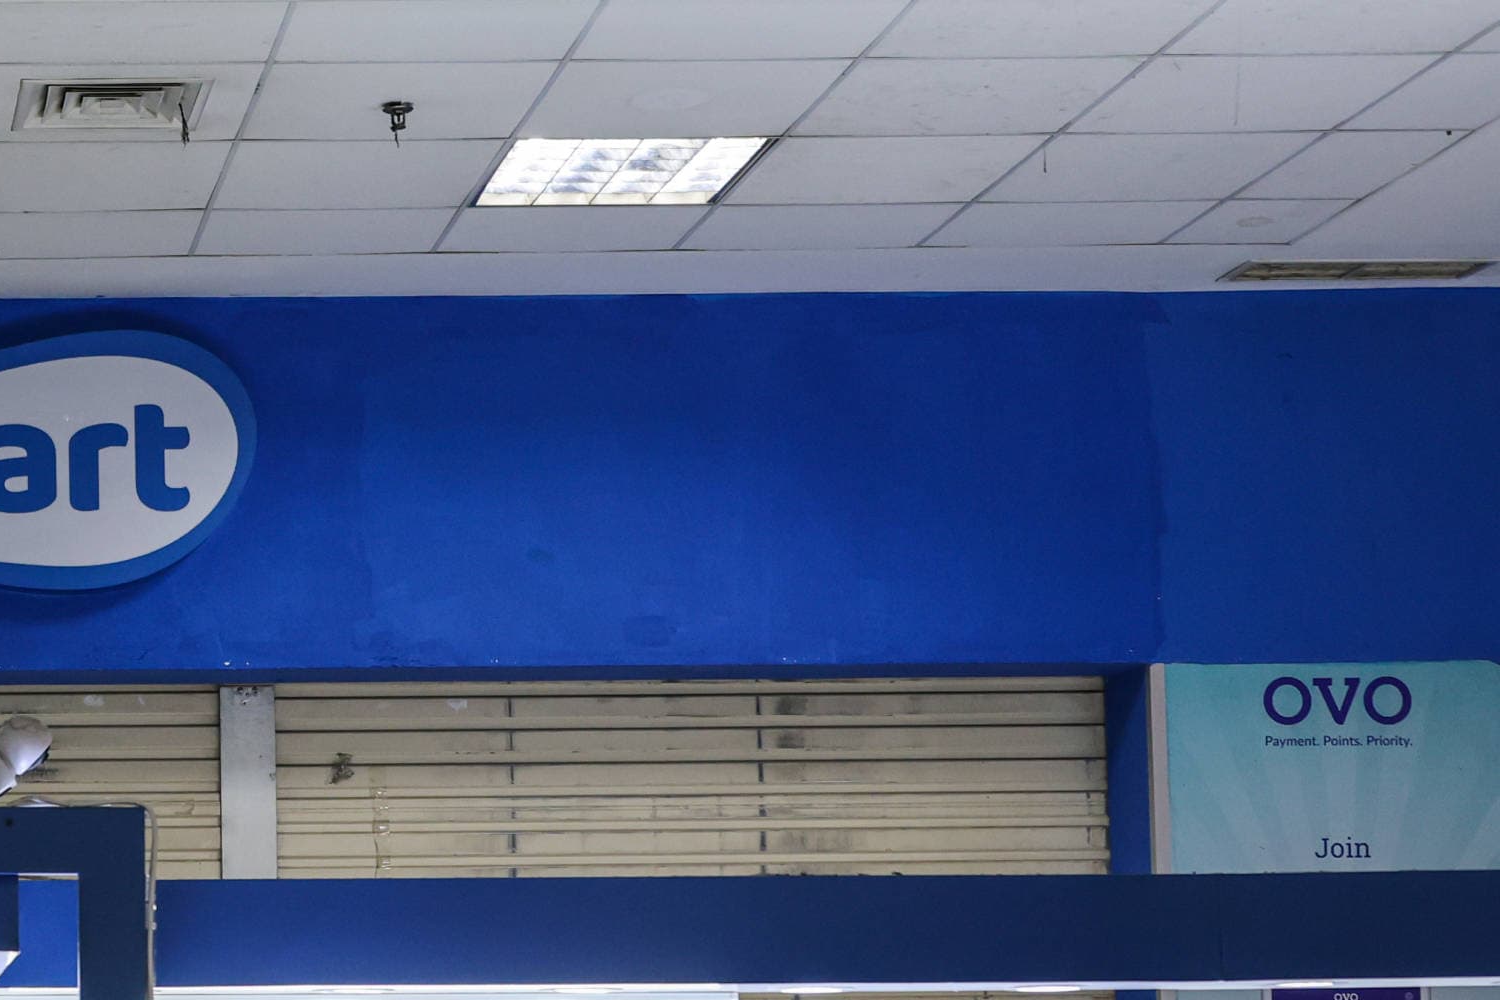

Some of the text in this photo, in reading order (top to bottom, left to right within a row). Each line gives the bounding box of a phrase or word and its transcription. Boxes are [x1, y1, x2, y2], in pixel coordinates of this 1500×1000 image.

[1263, 676, 1412, 725] OVO
[1265, 735, 1413, 749] Payment. Points. Priority.
[1315, 836, 1371, 859] Join
